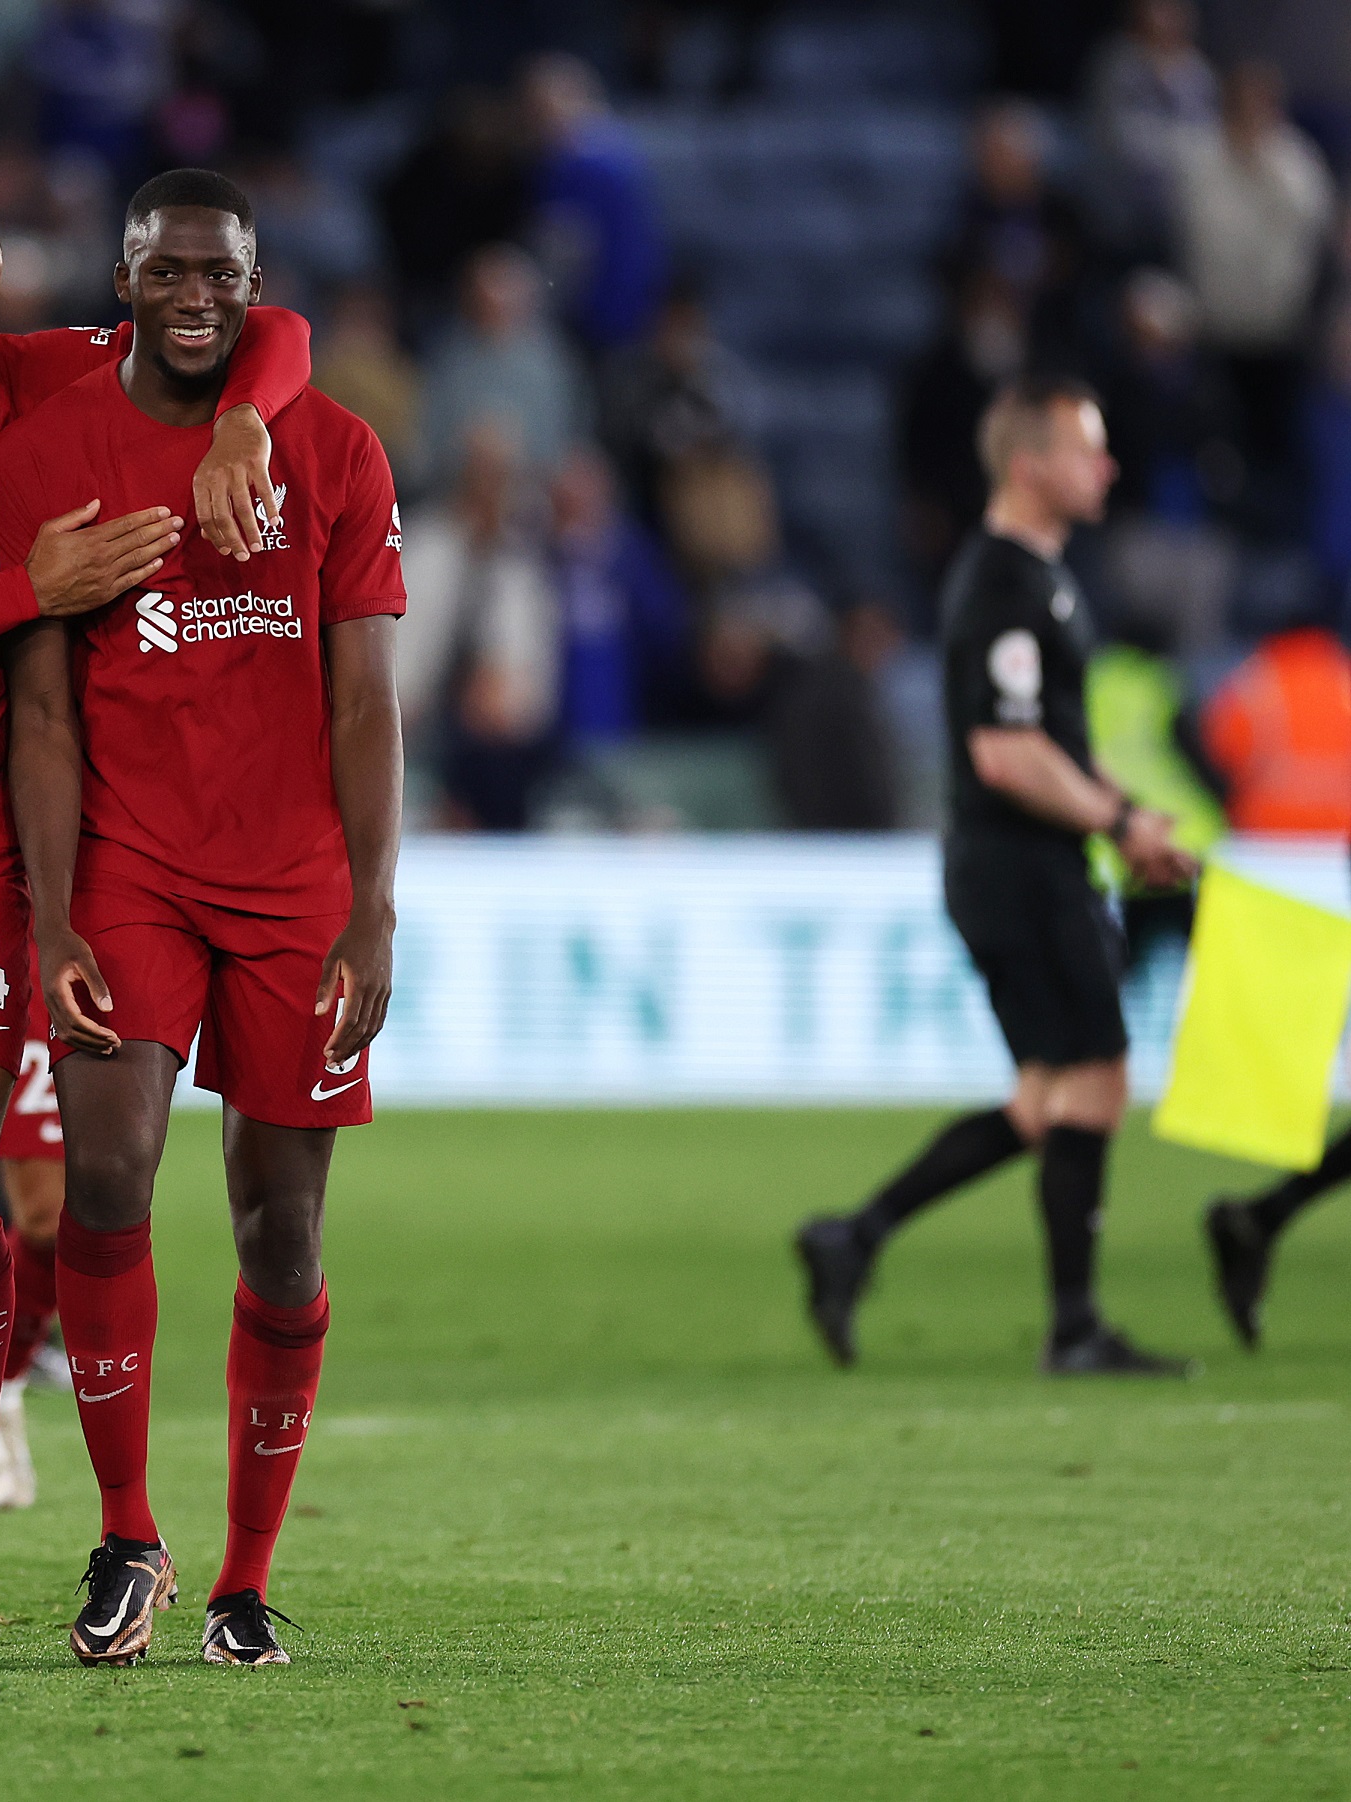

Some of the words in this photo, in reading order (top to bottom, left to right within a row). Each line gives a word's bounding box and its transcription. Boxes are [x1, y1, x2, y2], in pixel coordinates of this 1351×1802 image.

[181, 590, 293, 620] standard
[182, 613, 302, 642] chartered
[14, 1040, 59, 1114] 2
